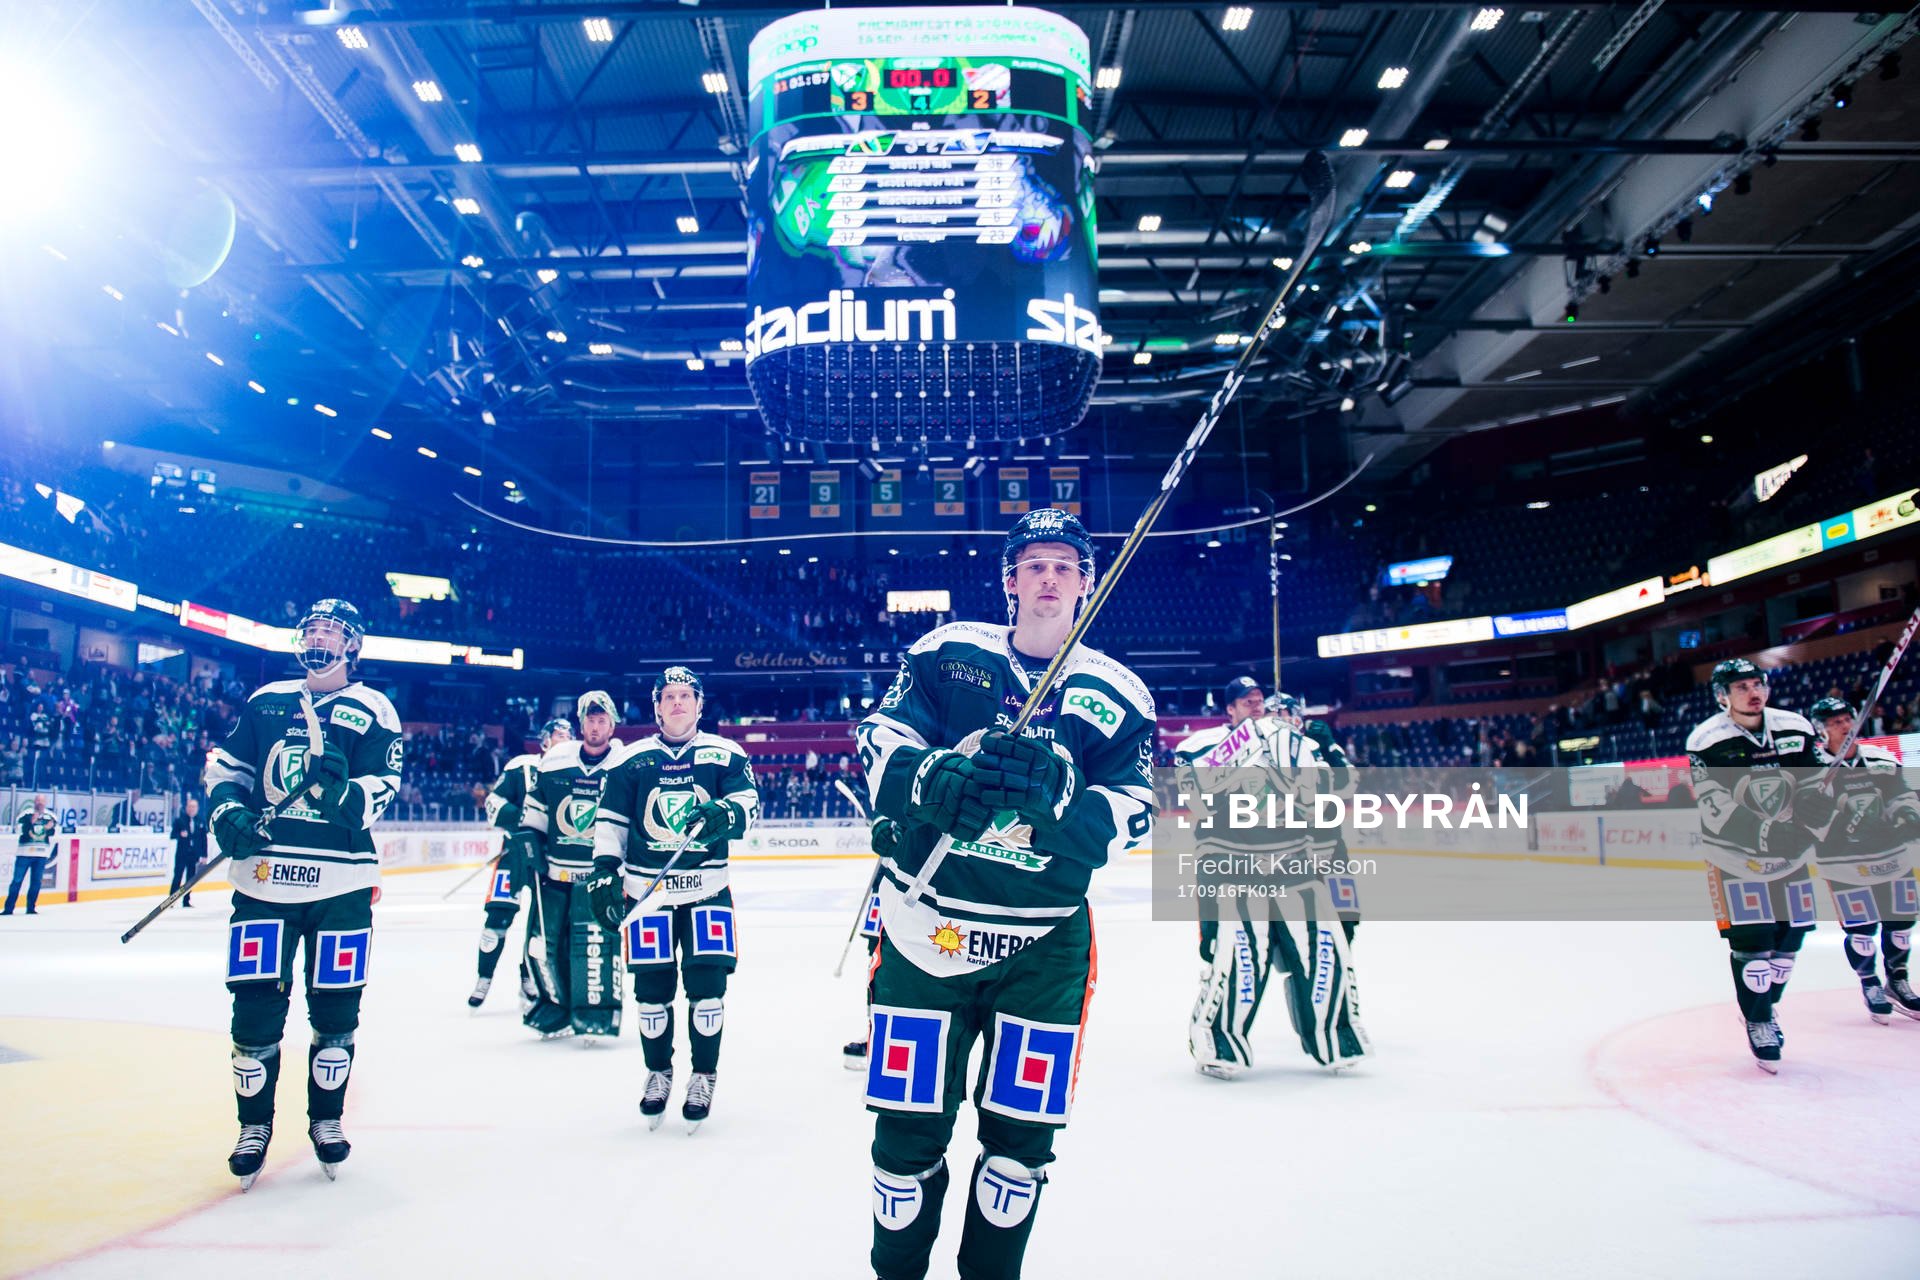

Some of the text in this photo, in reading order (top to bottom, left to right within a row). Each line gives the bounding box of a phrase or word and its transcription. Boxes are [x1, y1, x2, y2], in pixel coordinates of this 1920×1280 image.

[851, 91, 868, 110] 3
[972, 89, 990, 109] 2
[755, 486, 776, 504] 21
[818, 485, 831, 502] 9
[880, 483, 893, 501] 5
[943, 482, 956, 500] 2
[1008, 482, 1021, 499] 9
[1056, 482, 1075, 500] 17
[735, 652, 804, 668] Golden
[806, 650, 848, 667] Star
[940, 660, 992, 681] GRÖNSAKS
[951, 670, 984, 686] HUSET
[333, 709, 367, 727] coop
[1068, 694, 1117, 726] coop
[658, 775, 695, 785] stadium
[1759, 783, 1771, 799] F
[575, 804, 585, 817] F
[667, 797, 678, 814] F
[123, 847, 168, 863] FRAKT
[961, 841, 1028, 862] KARLSTAD
[272, 863, 321, 883] ENERGI
[586, 923, 605, 1006] Helmia
[1235, 929, 1254, 1005] Helmia
[1314, 929, 1334, 1005] Helmia
